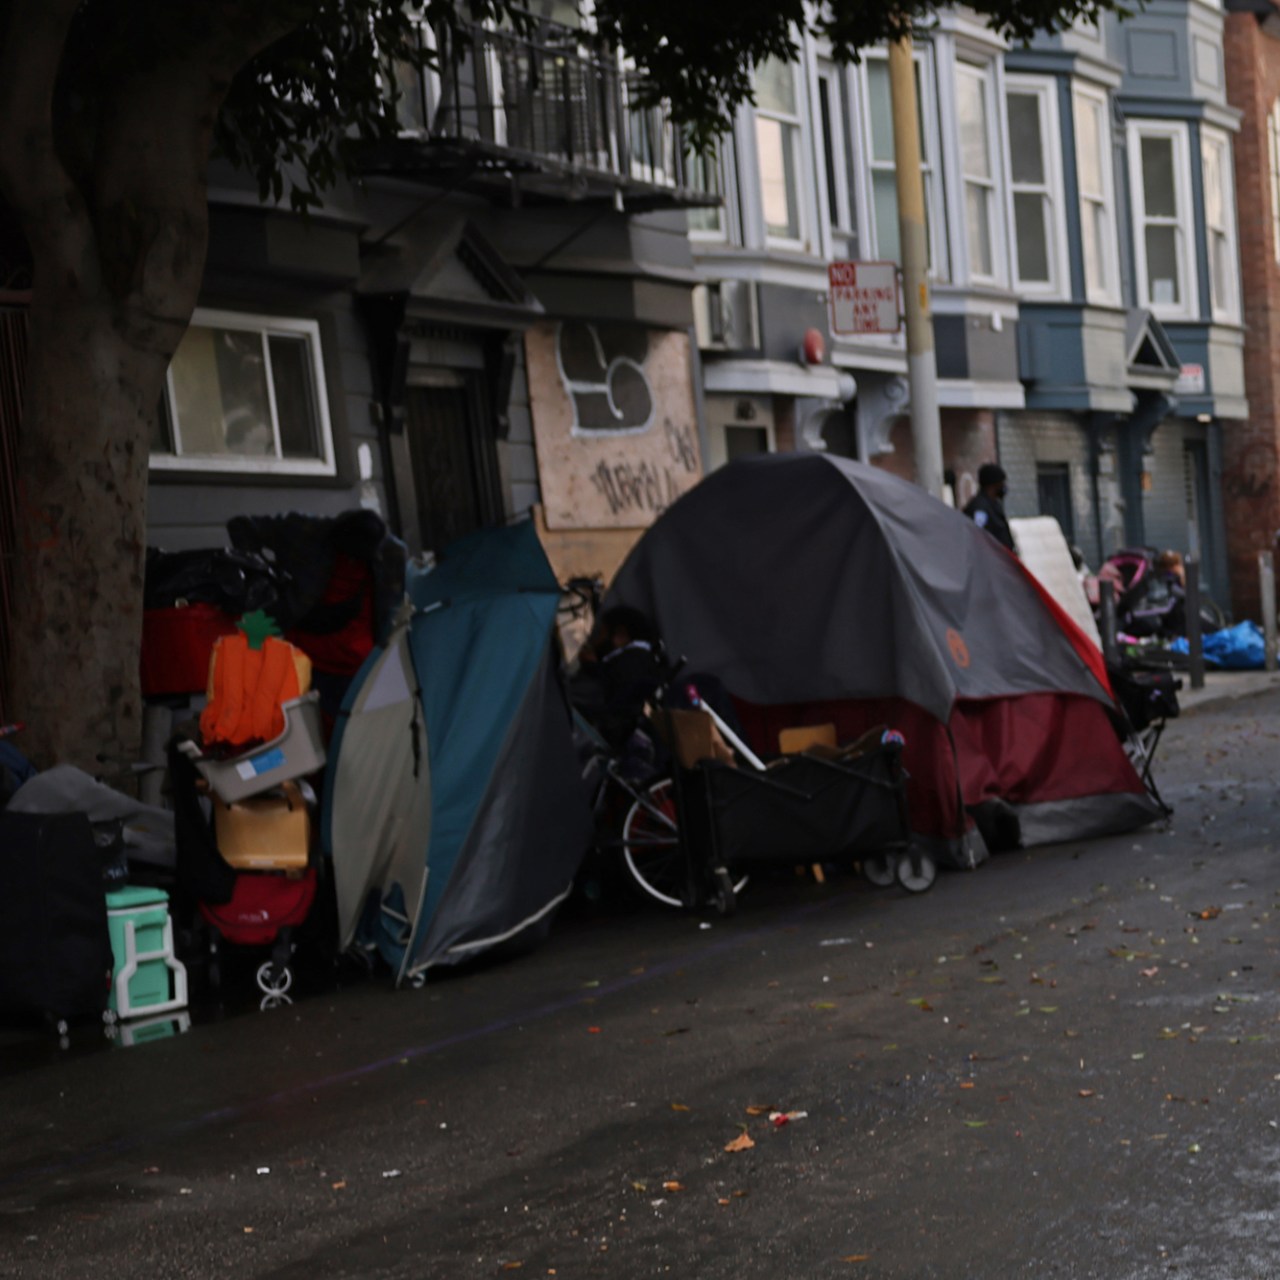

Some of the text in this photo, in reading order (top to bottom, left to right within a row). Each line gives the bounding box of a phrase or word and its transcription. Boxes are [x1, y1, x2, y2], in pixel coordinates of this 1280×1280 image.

[832, 266, 853, 282] NO
[836, 288, 893, 302] PARKING
[853, 303, 878, 316] ANY
